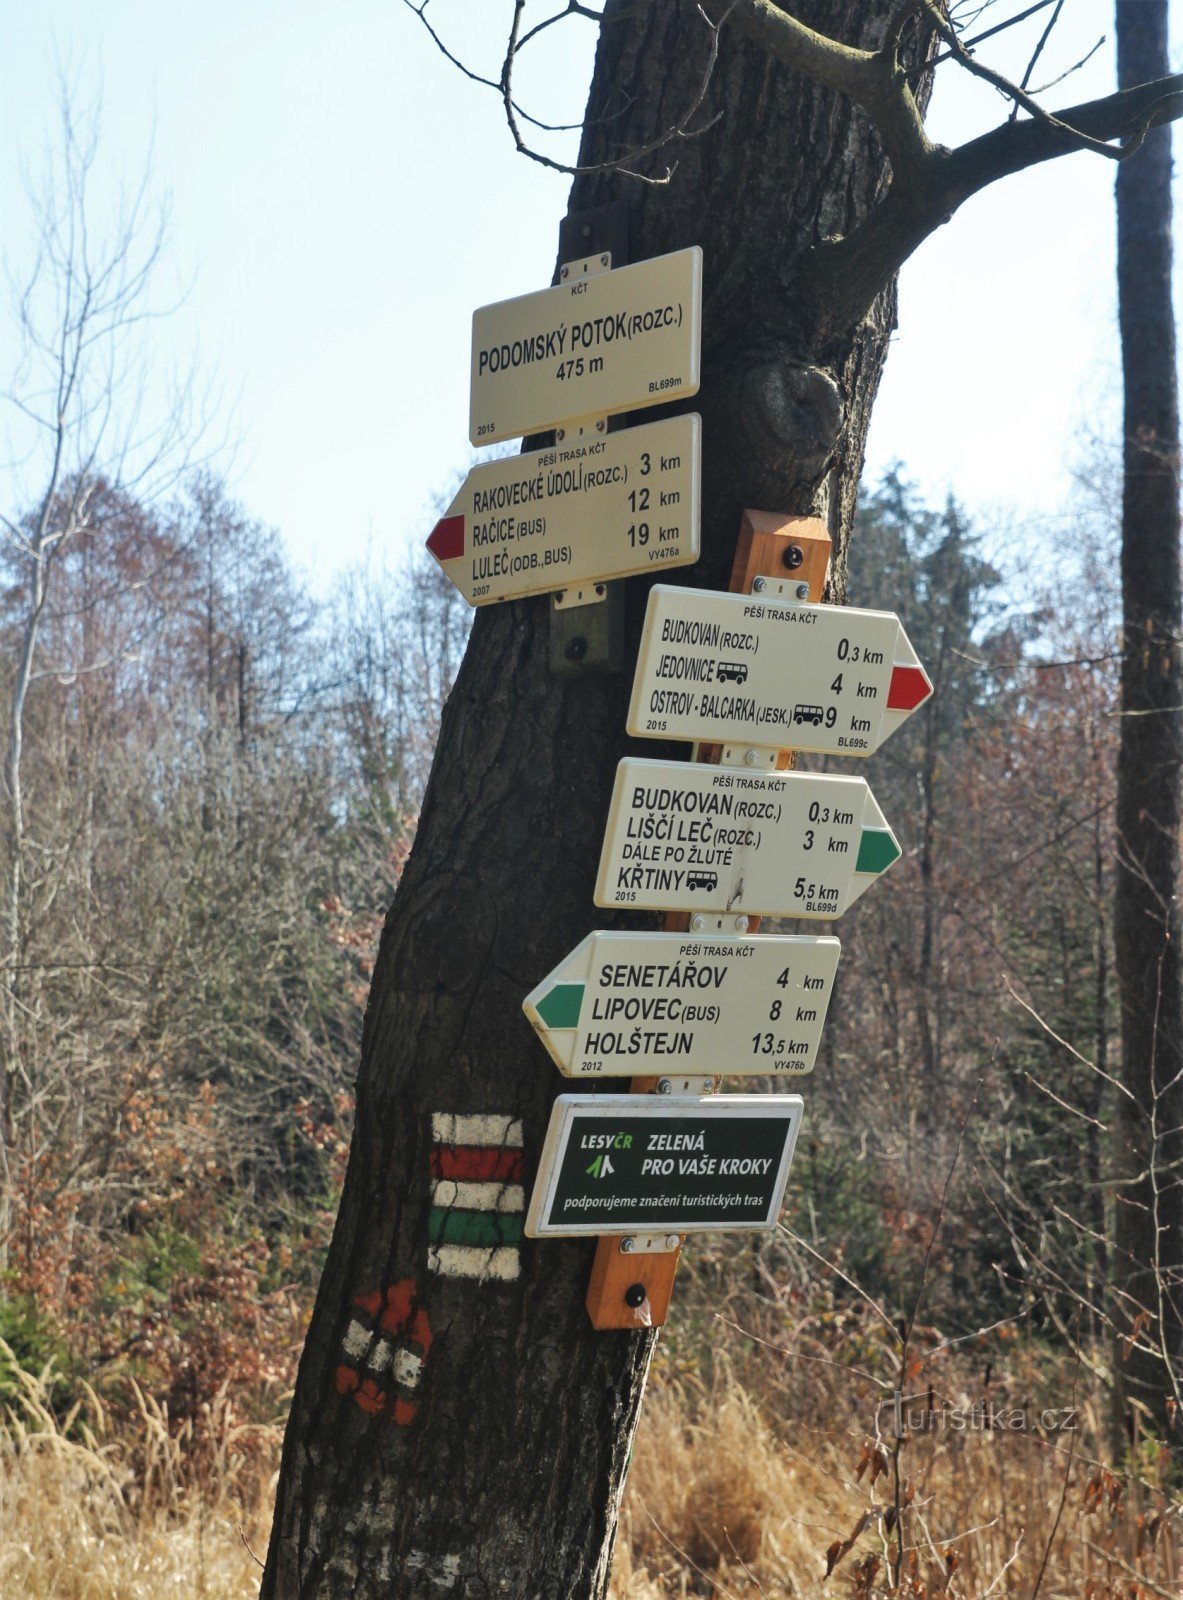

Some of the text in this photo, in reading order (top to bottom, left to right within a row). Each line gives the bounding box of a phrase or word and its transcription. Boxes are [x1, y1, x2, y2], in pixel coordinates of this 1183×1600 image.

[571, 283, 588, 296] KČT
[479, 323, 567, 376] PODOMSKÝ
[556, 356, 604, 380] 475 m
[649, 377, 682, 393] BL699m
[477, 423, 495, 436] 2015
[538, 443, 607, 468] PĚŠÍ TRASA KČT
[640, 453, 681, 475] 3 km
[473, 472, 544, 514] RAKOVECKÉ
[628, 489, 680, 513] 12 km
[627, 522, 679, 548] 19 km
[649, 547, 679, 561] VY476a
[472, 585, 490, 597] 2007
[744, 606, 817, 624] PĚŠÍ TRASA KČT
[836, 638, 884, 664] 0,3 km
[656, 654, 715, 683] JEDOVNICE
[830, 674, 877, 698] 4 km
[650, 690, 694, 715] OSTROV
[646, 720, 667, 731] 2015
[824, 706, 871, 732] 9 km
[838, 736, 868, 749] BL699c
[712, 776, 786, 792] PĚŠÍ TRASA KČT
[808, 801, 854, 825] 0,3 km
[626, 813, 675, 841] LIŠČÍ
[802, 830, 848, 853] 3 km
[622, 841, 733, 866] DÁLE PO ŽLUTÉ
[617, 864, 686, 891] KŘTINY
[615, 891, 636, 902] 2015
[794, 878, 839, 901] 5,5 km
[806, 902, 837, 913] BL699d
[680, 944, 755, 957] PĚŠÍ TRASA KČT
[600, 961, 727, 988] SENETÁŘOV
[777, 967, 824, 990] 4 km
[769, 1000, 817, 1022] 8 km
[584, 1027, 694, 1054] HOLŠTEJN
[751, 1033, 809, 1056] 13,5 km
[581, 1061, 602, 1071] 2012
[774, 1060, 805, 1070] VY476b
[647, 1131, 706, 1150] ZELENÁ
[641, 1154, 772, 1175] PRO VAŠE KROKY
[564, 1193, 763, 1211] podporujeme značení turistických tras
